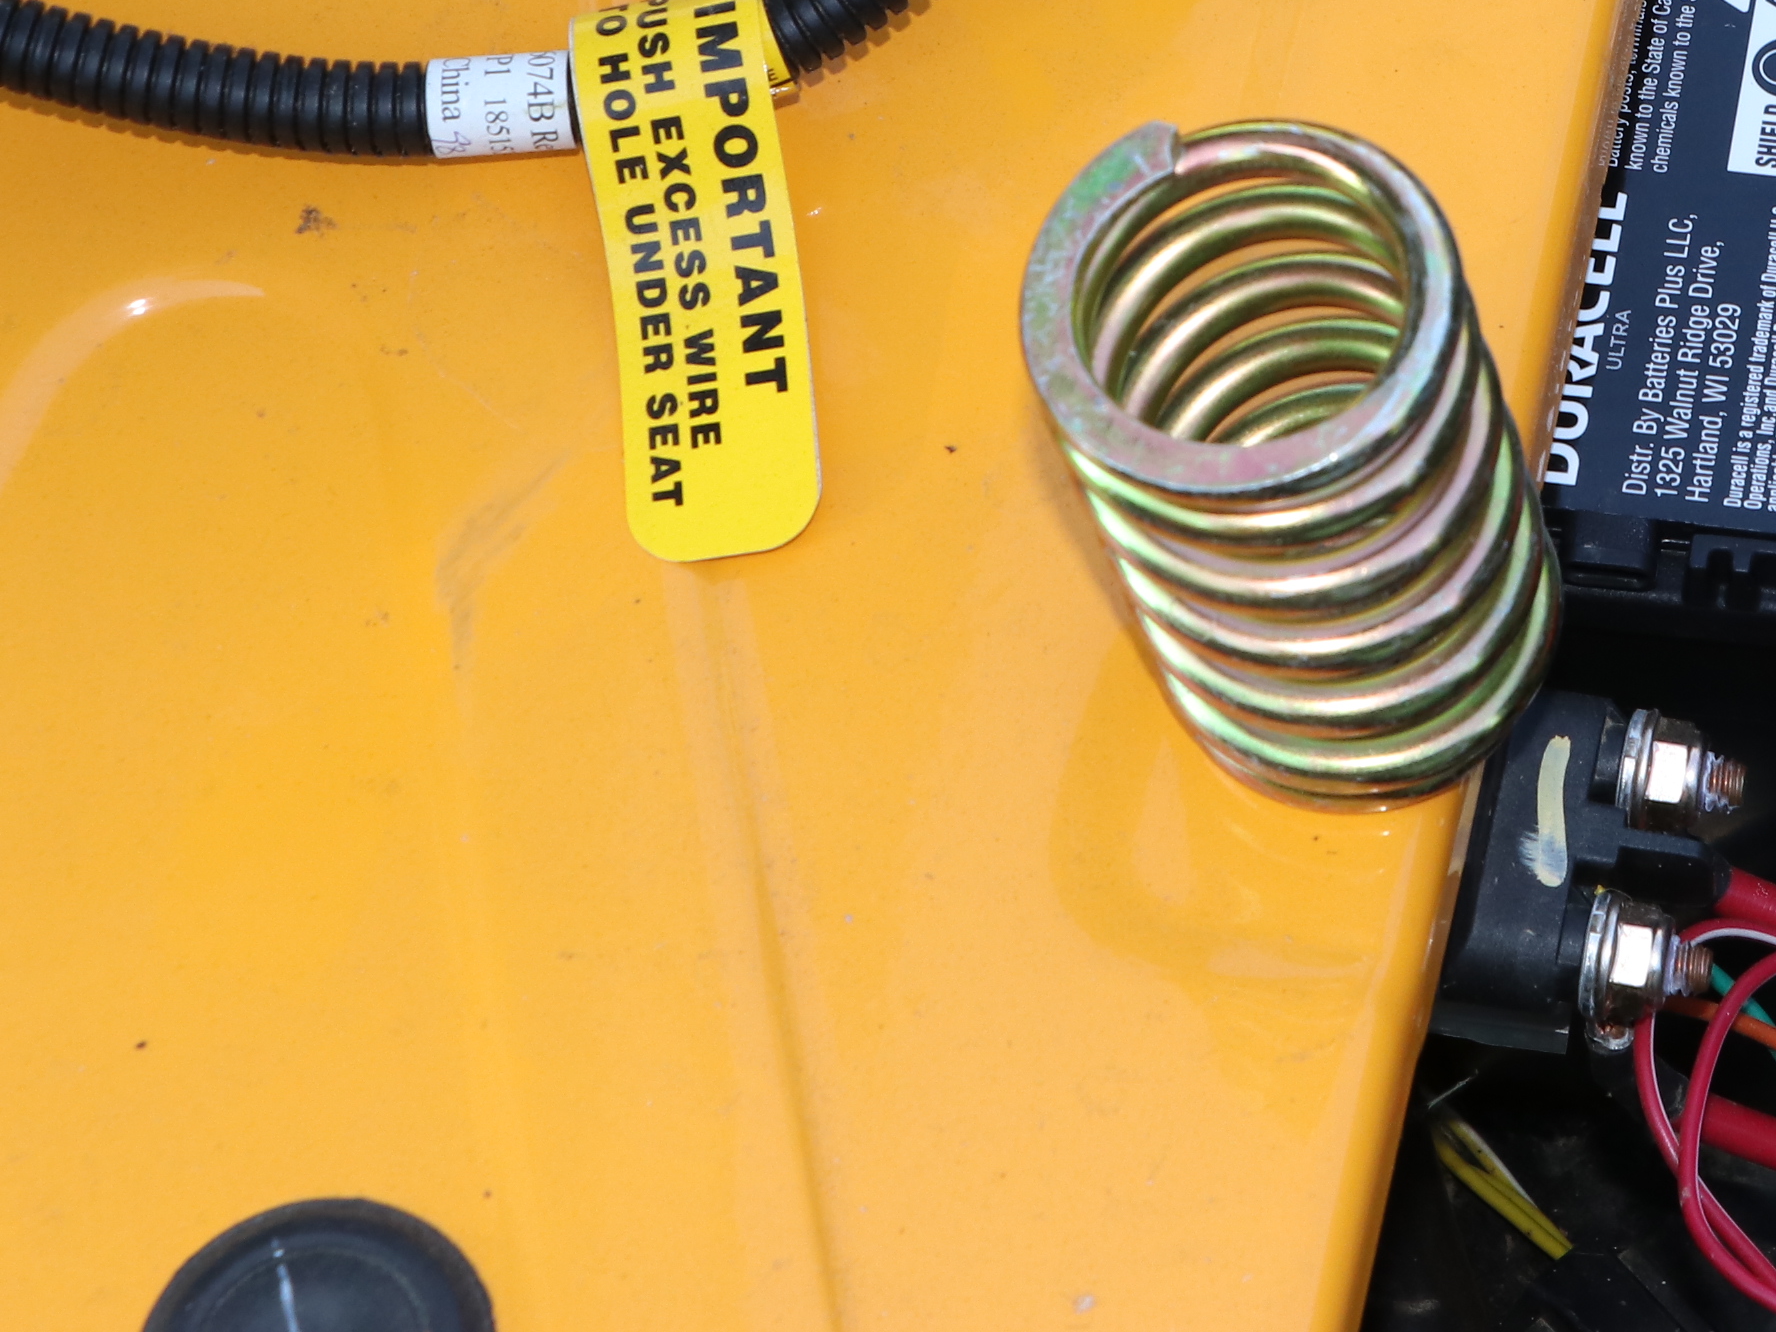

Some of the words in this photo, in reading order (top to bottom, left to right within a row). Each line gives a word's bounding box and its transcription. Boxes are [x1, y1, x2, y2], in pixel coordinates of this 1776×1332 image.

[1672, 31, 1691, 46] to
[1675, 5, 1696, 28] the
[1662, 50, 1688, 98] known
[597, 53, 650, 184] HOLE
[1650, 101, 1679, 173] chemicals
[693, 0, 790, 396] IMPORTANT
[1663, 214, 1698, 259] LLC,
[623, 203, 674, 376] UNDER
[650, 117, 712, 309] EXCESS
[681, 327, 723, 451] WIRE
[1654, 265, 1686, 309] Plus
[1688, 241, 1725, 299] Drive,
[1605, 309, 1632, 370] ULTRA
[1638, 315, 1677, 403] Batteries
[1676, 305, 1713, 363] Ridge
[1708, 303, 1742, 369] 53029
[1662, 368, 1699, 440] Walnut
[1701, 375, 1730, 403] WI
[1739, 364, 1767, 427] registered
[644, 392, 686, 508] SEAT
[1632, 407, 1665, 435] By
[1732, 441, 1752, 453] is
[1738, 429, 1758, 439] a
[1621, 443, 1654, 495] Distr.
[1654, 446, 1686, 497] 1325
[1684, 411, 1728, 503] Hartland,
[1723, 455, 1753, 508] Duracell
